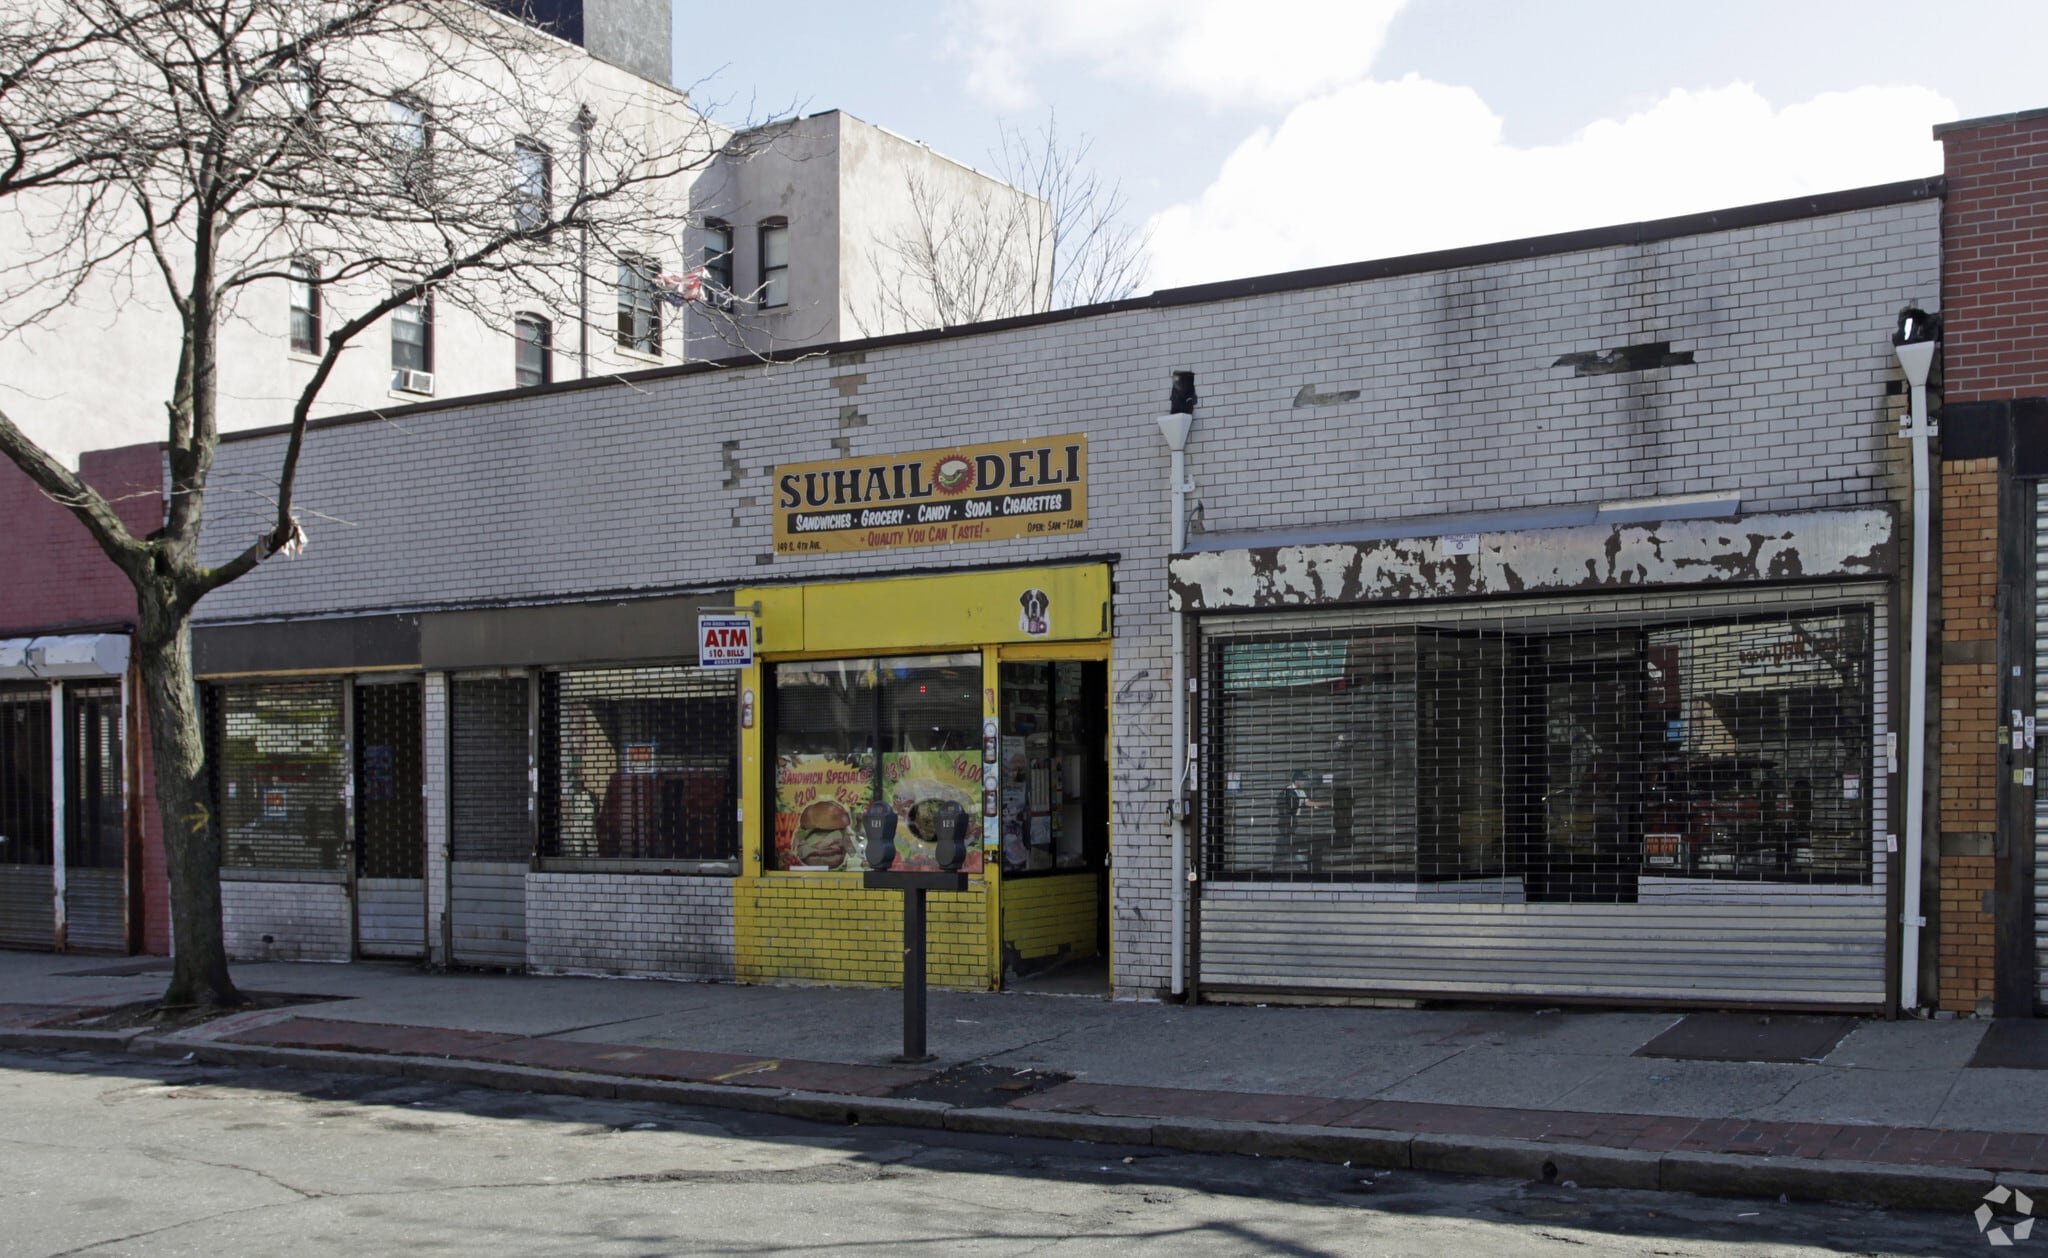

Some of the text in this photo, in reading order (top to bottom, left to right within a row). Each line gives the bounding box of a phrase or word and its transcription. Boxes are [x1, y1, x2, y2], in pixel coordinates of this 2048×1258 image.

[780, 445, 1080, 509] SUHAIL DELI
[795, 493, 1062, 532] SANDWICHES GROCERY CANDY SODA CIGARETTES
[867, 521, 984, 547] QUALITY YOU CAN TASTE!
[705, 628, 748, 648] ATM
[727, 649, 744, 657] BILLS
[780, 769, 823, 785] SANDWICH
